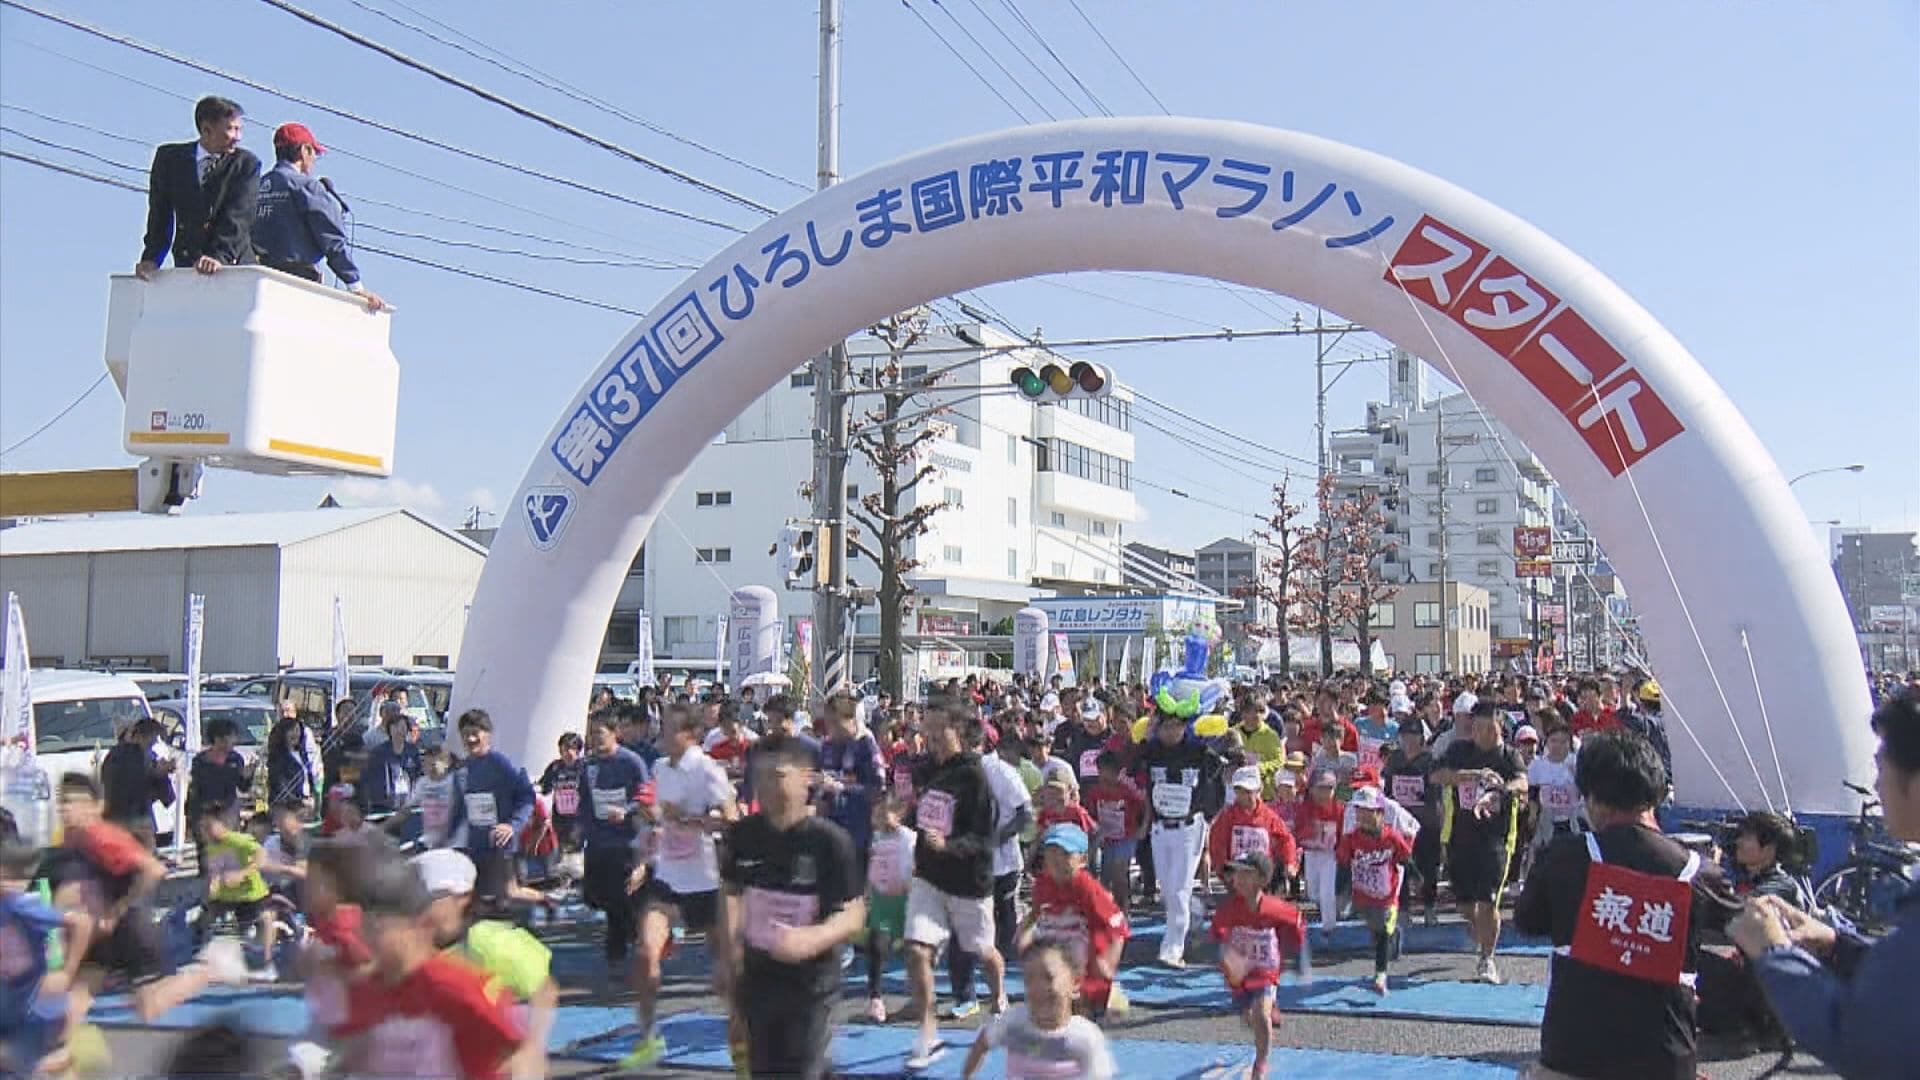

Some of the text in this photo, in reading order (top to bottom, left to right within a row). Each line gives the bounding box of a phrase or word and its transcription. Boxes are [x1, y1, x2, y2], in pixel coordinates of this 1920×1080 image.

[554, 149, 1650, 482] 第37回 ひろしま国際平和マラソン スタート
[183, 412, 205, 430] 200
[1059, 607, 1154, 622] 広島レンタカー
[1591, 886, 1674, 942] 報道
